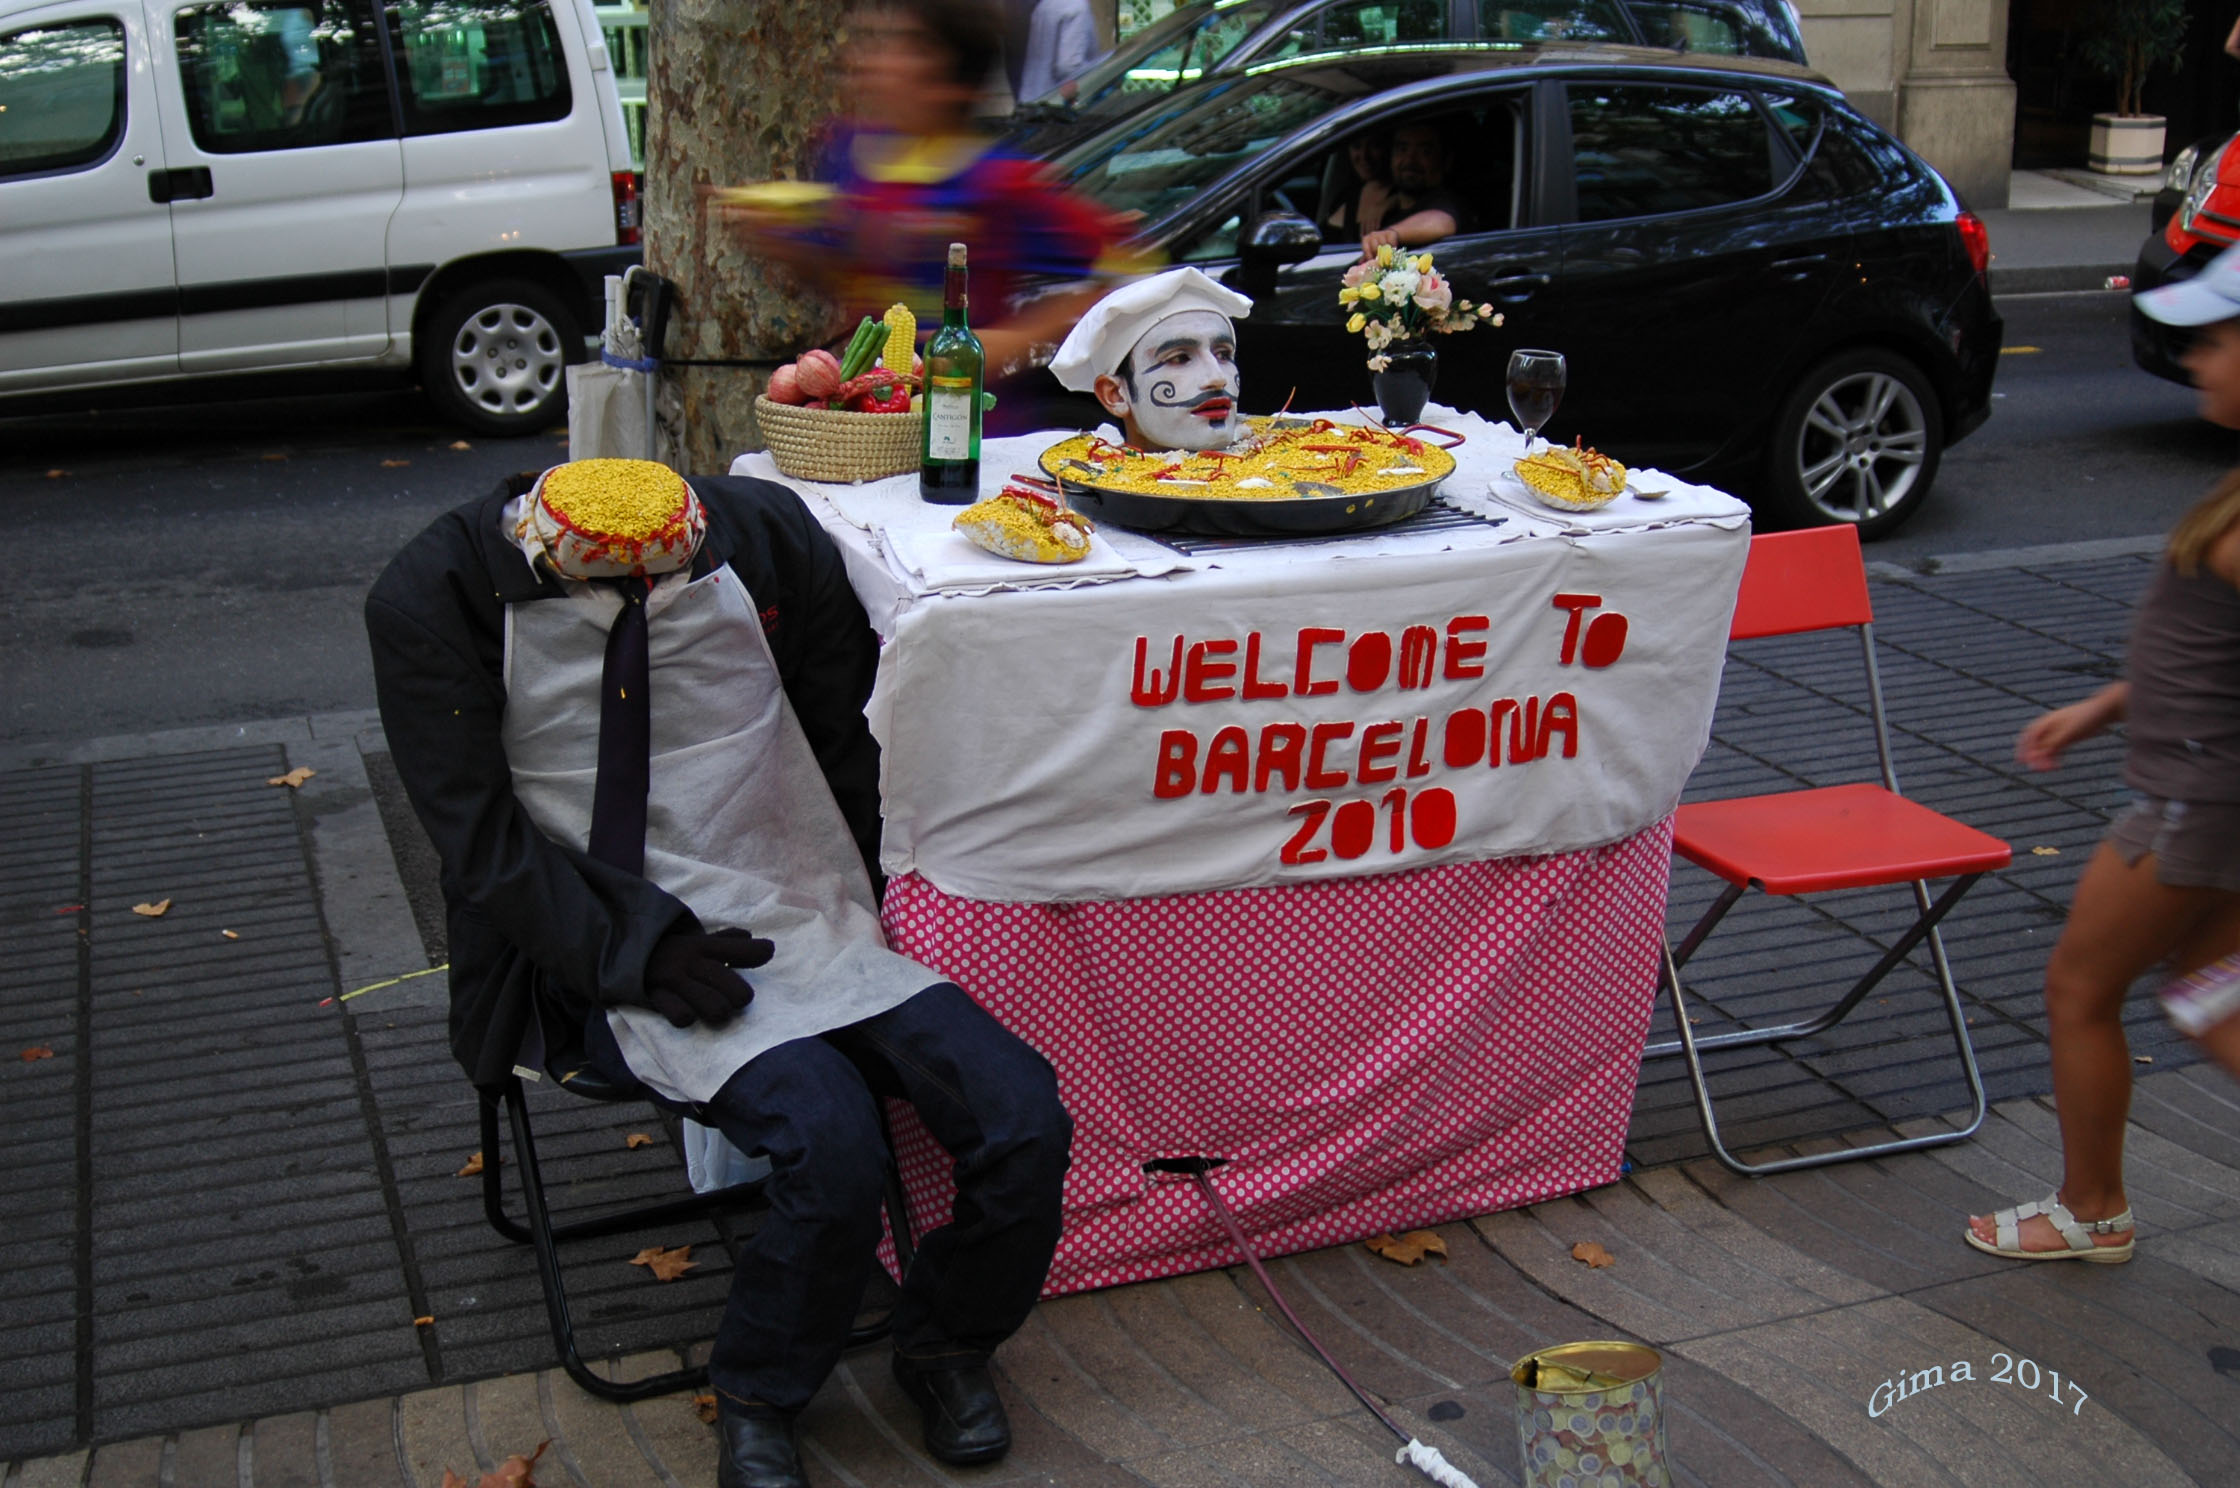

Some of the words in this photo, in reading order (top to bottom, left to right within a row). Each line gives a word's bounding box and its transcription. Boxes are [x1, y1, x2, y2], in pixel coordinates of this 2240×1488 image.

[1130, 615, 1491, 708] WELCOME
[1153, 692, 1579, 799] BARCELONA
[1279, 786, 1458, 865] 2010
